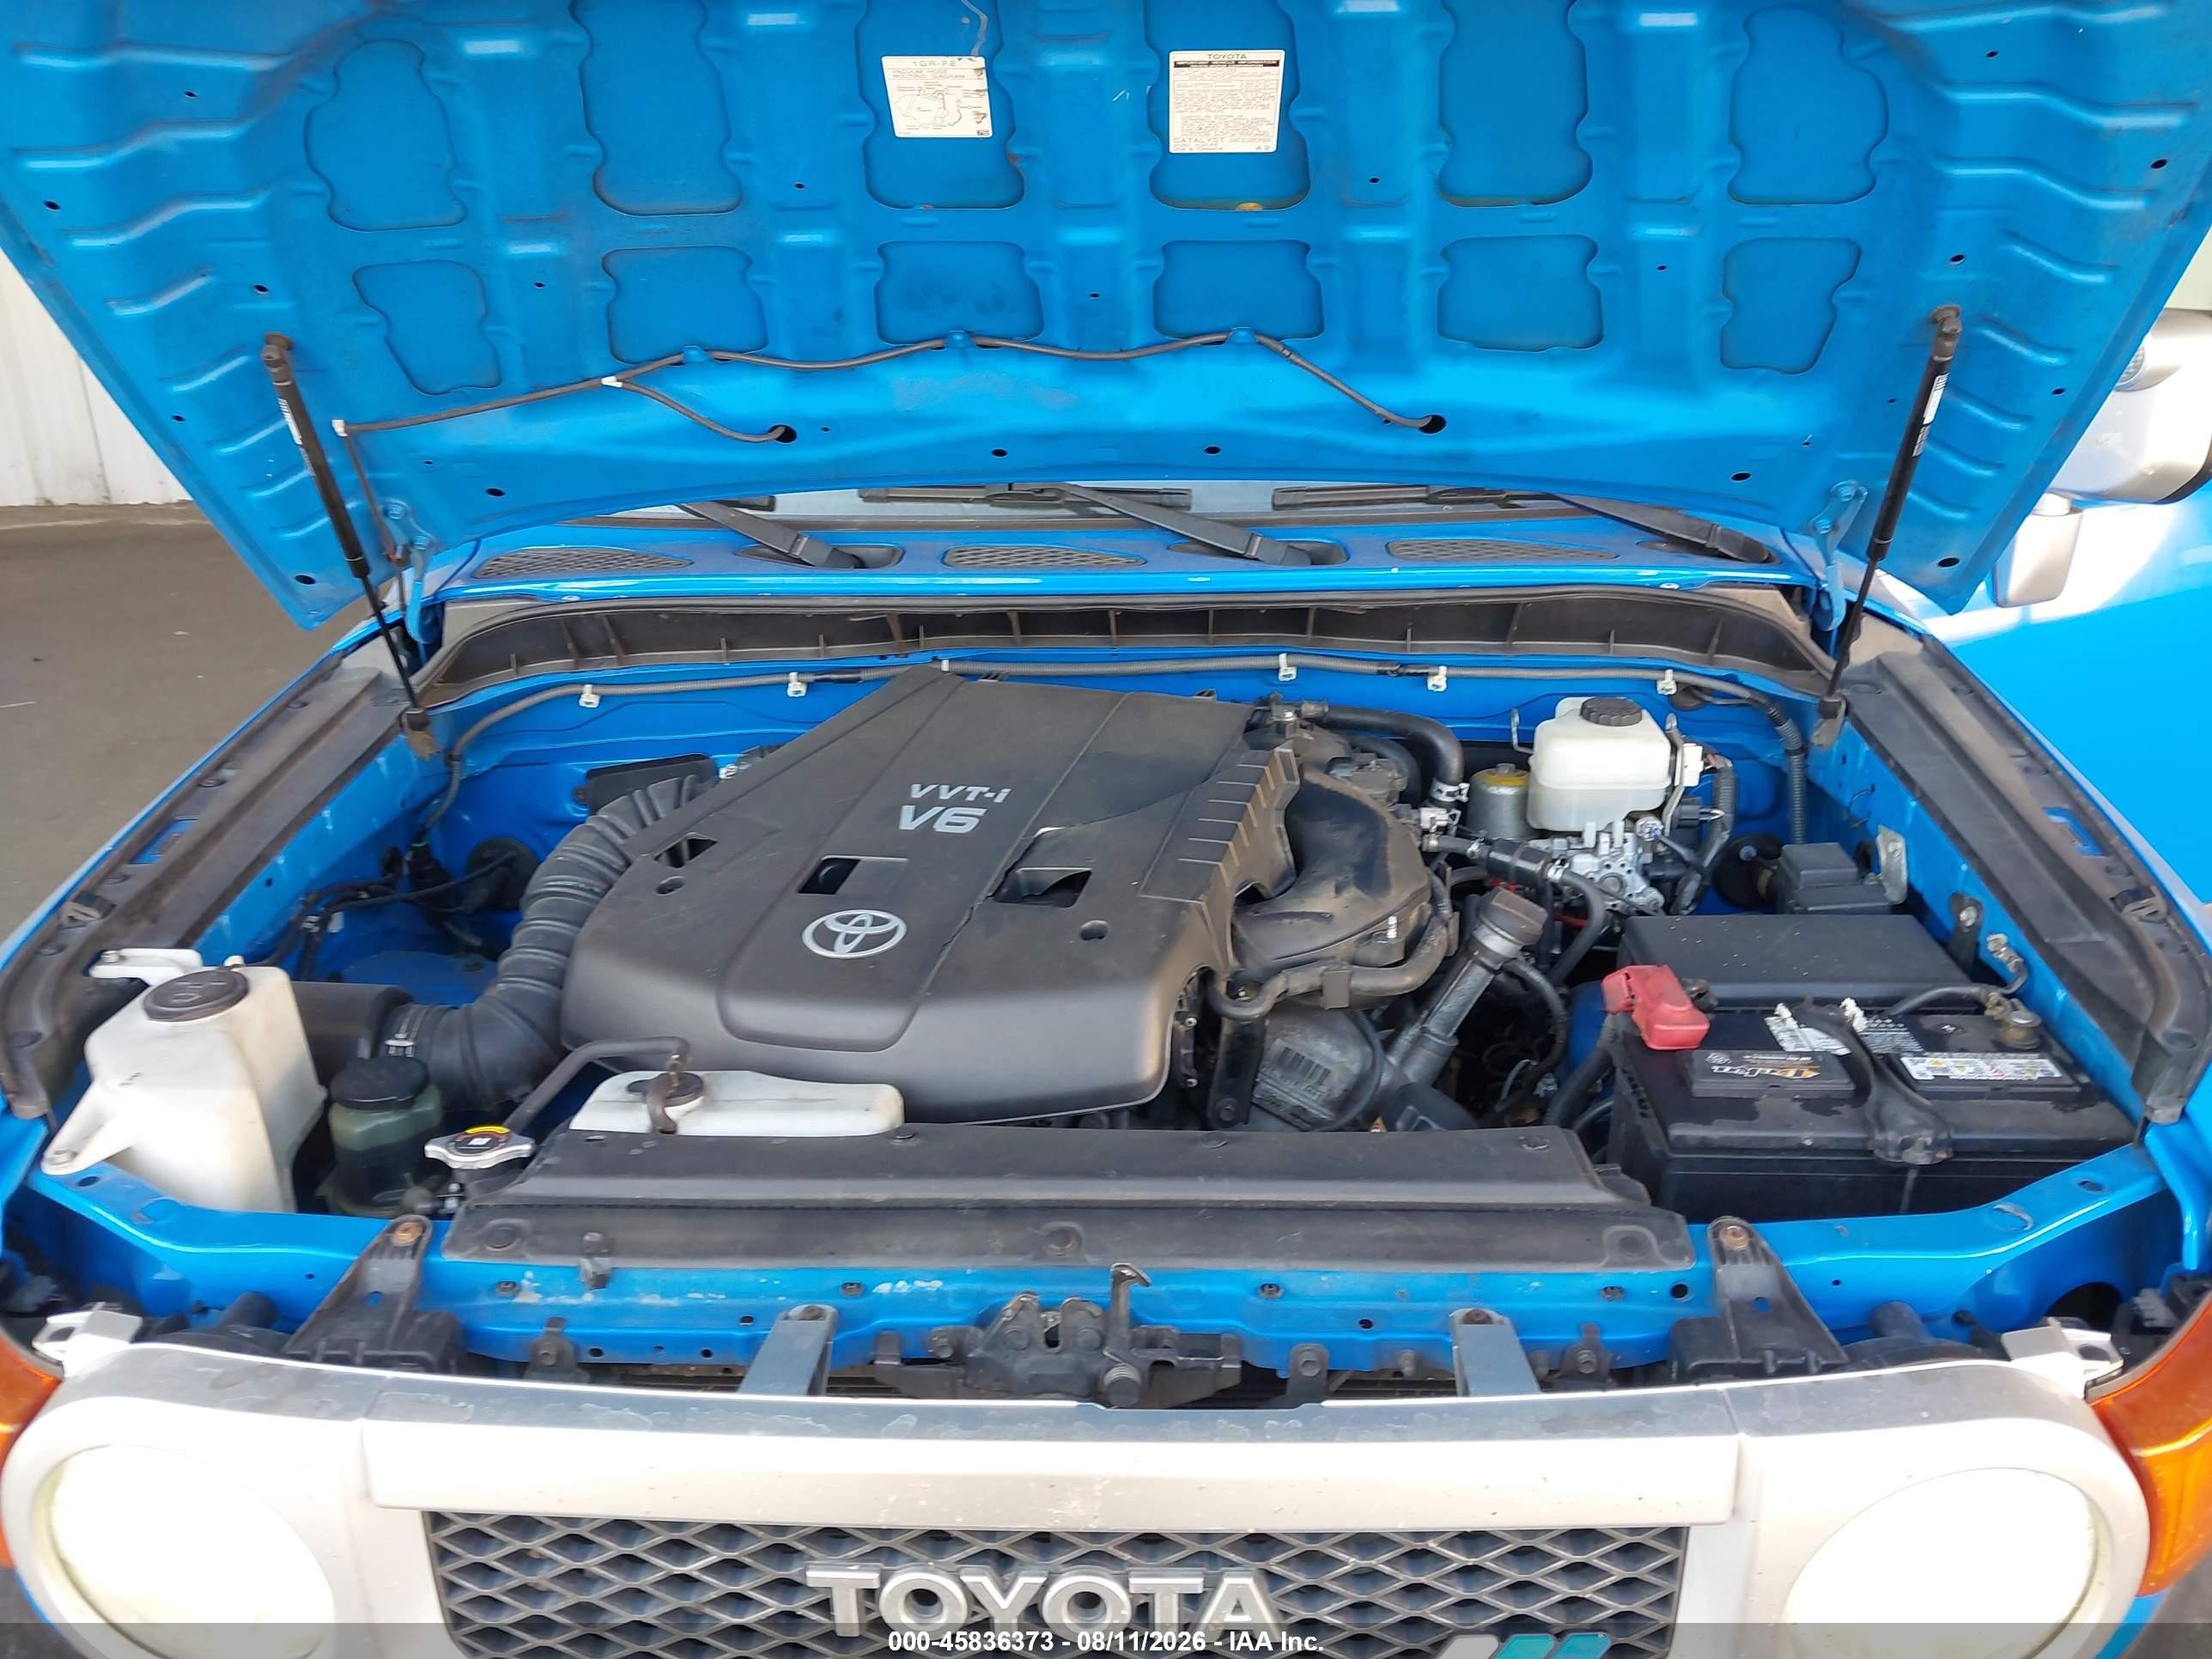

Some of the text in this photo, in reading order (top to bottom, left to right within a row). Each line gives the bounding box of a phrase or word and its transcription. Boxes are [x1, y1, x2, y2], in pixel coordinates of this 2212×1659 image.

[910, 783, 1012, 803] VVT-i
[898, 805, 988, 834] V6
[804, 1563, 1282, 1642] TOYOTA
